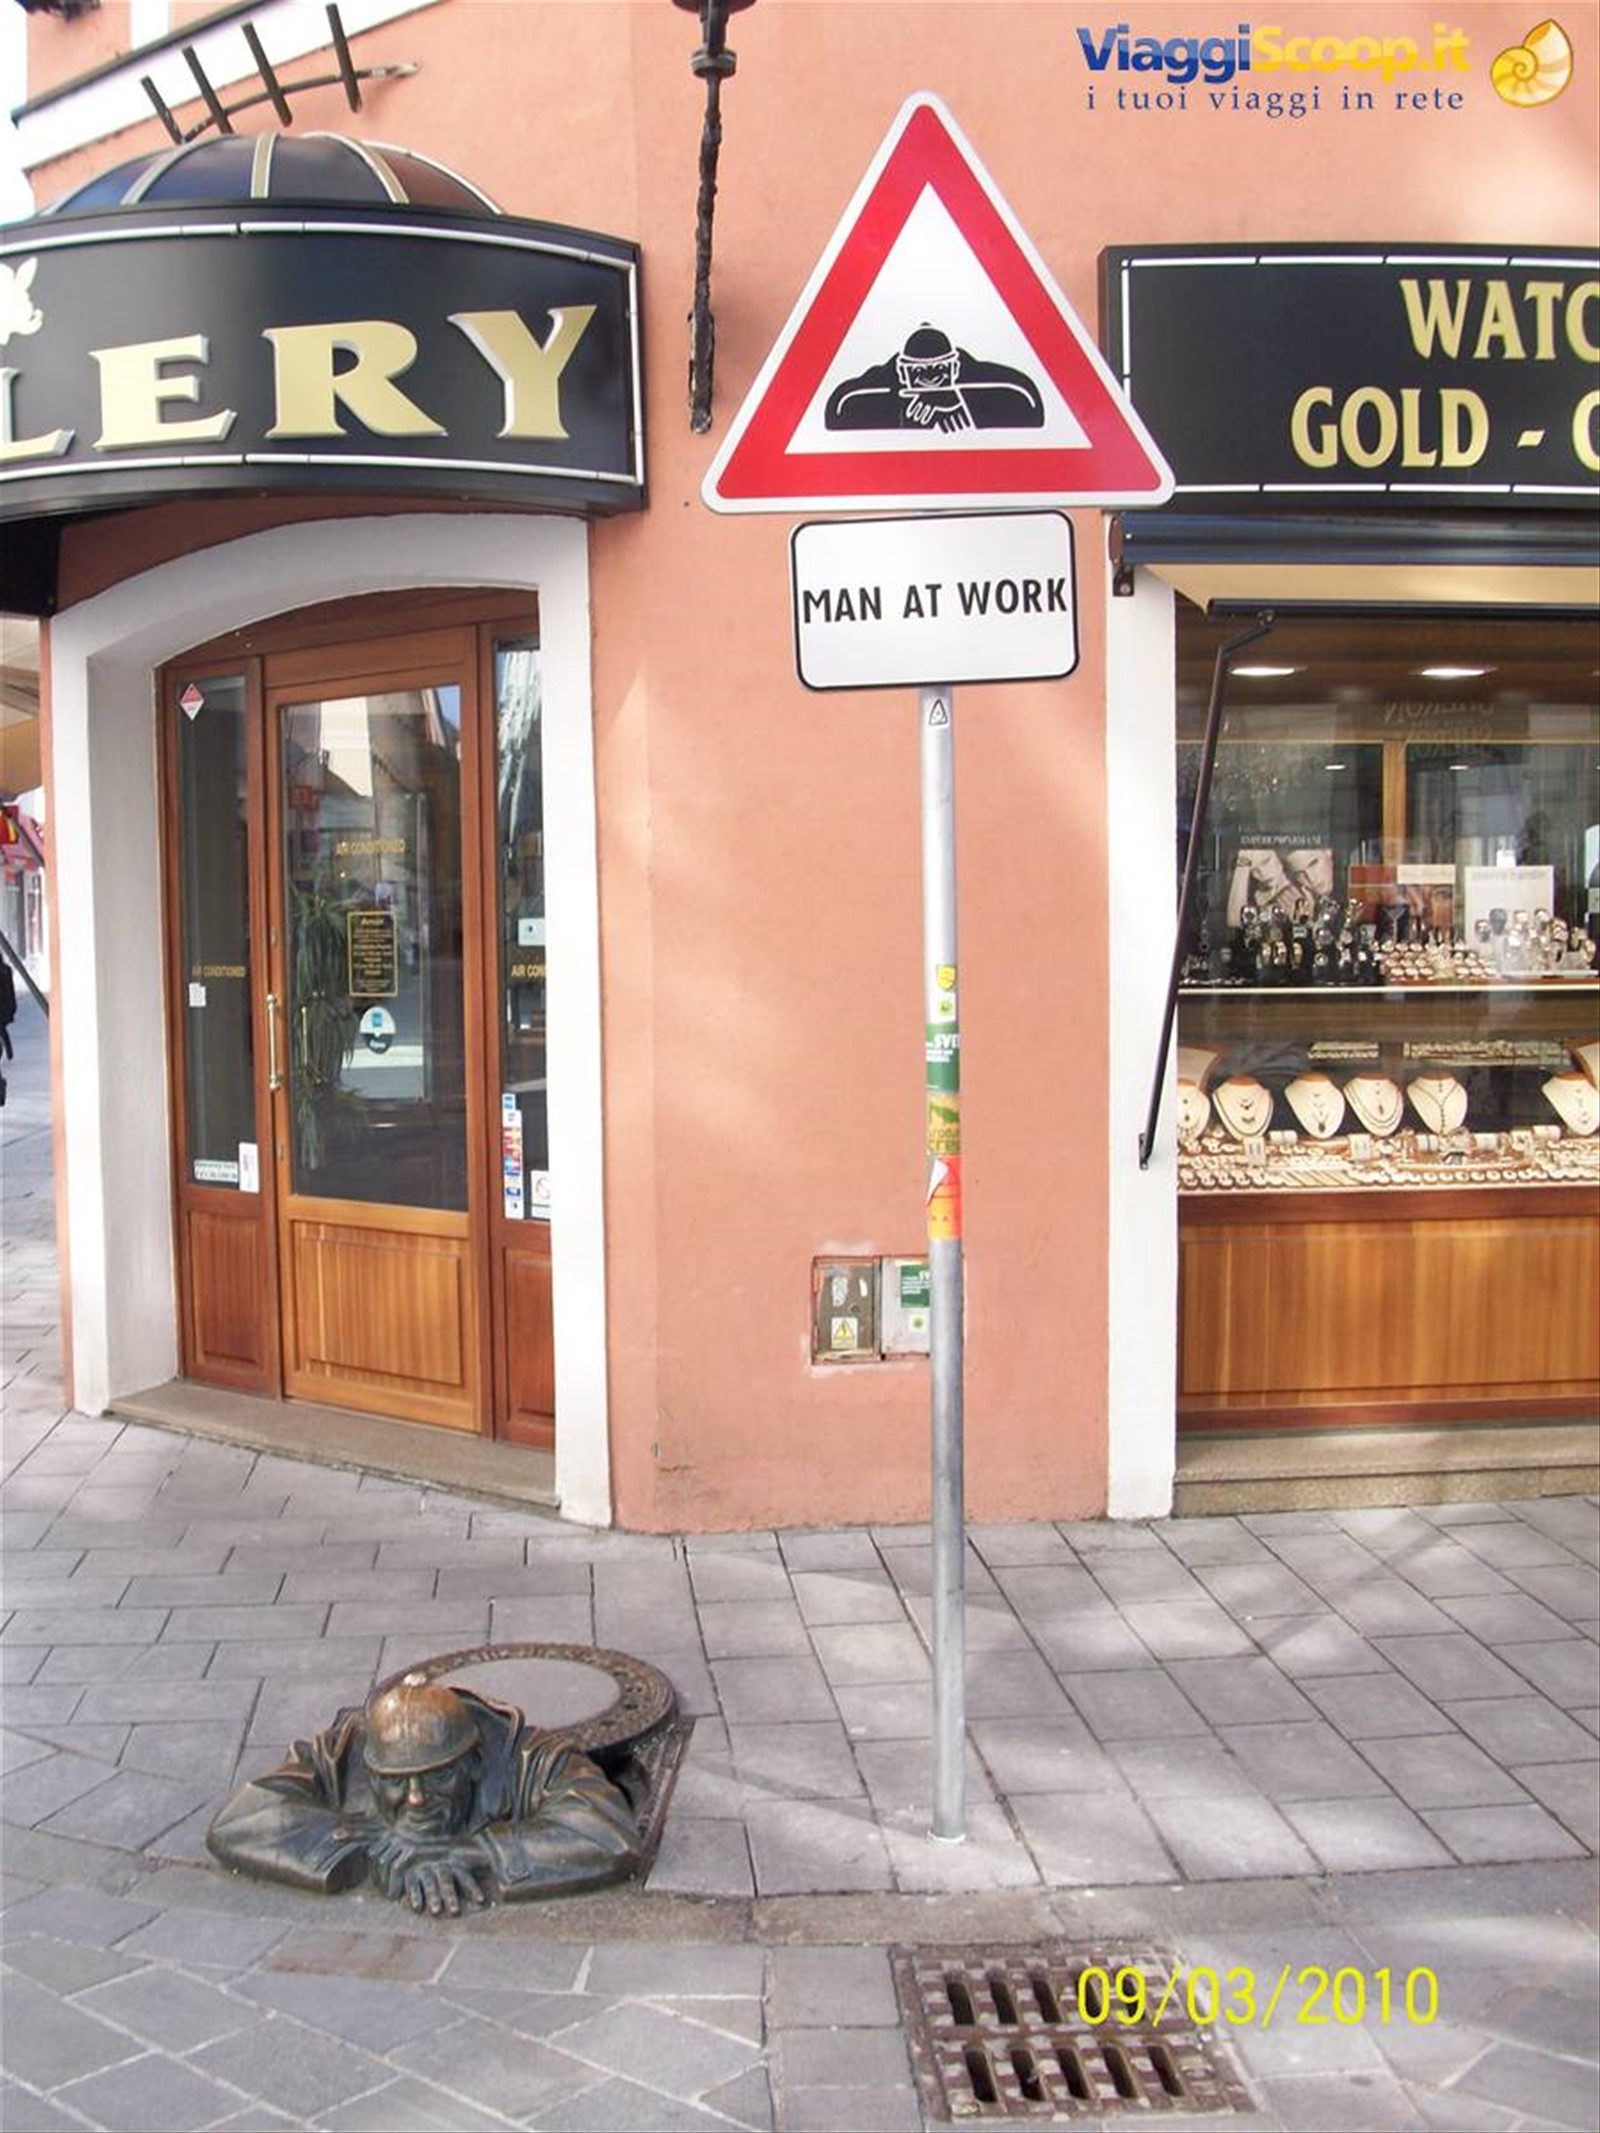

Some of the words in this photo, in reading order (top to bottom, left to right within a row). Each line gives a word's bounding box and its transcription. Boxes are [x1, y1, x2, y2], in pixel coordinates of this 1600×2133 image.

[1290, 385, 1490, 469] GOLD
[802, 585, 883, 624] MAN
[902, 583, 943, 619] AT
[956, 576, 1068, 617] WORK
